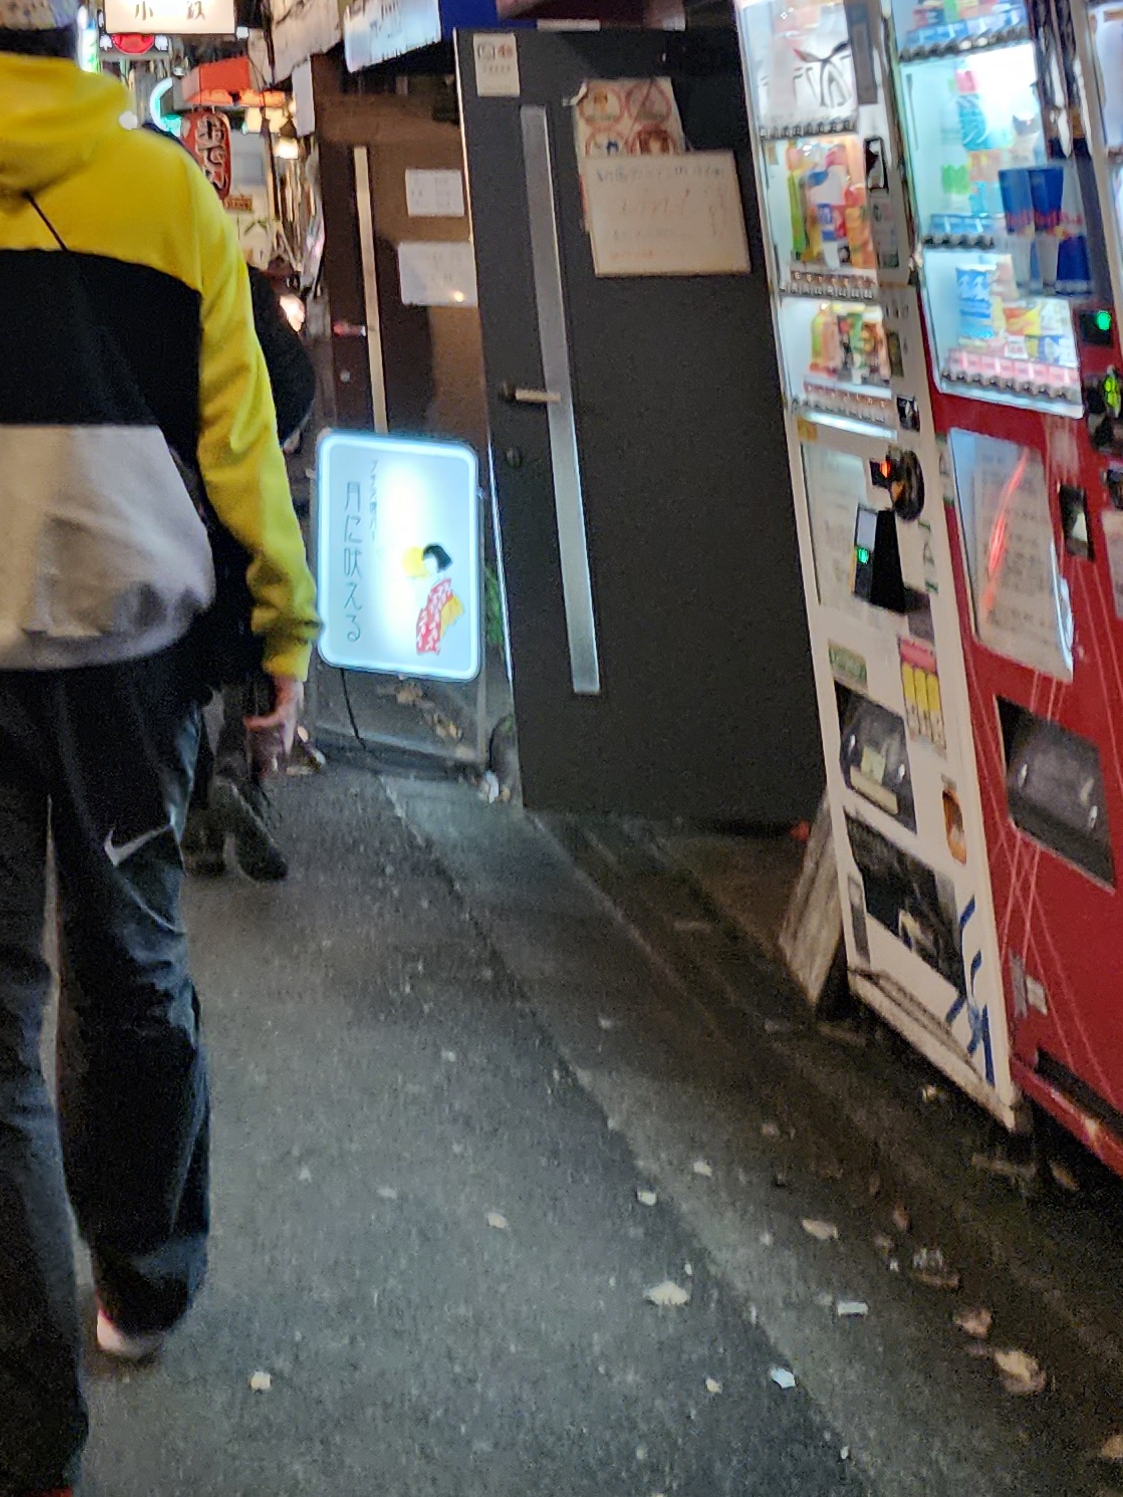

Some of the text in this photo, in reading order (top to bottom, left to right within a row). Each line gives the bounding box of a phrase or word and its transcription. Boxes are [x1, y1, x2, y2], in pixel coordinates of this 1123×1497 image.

[343, 481, 363, 643] 月に吠える
